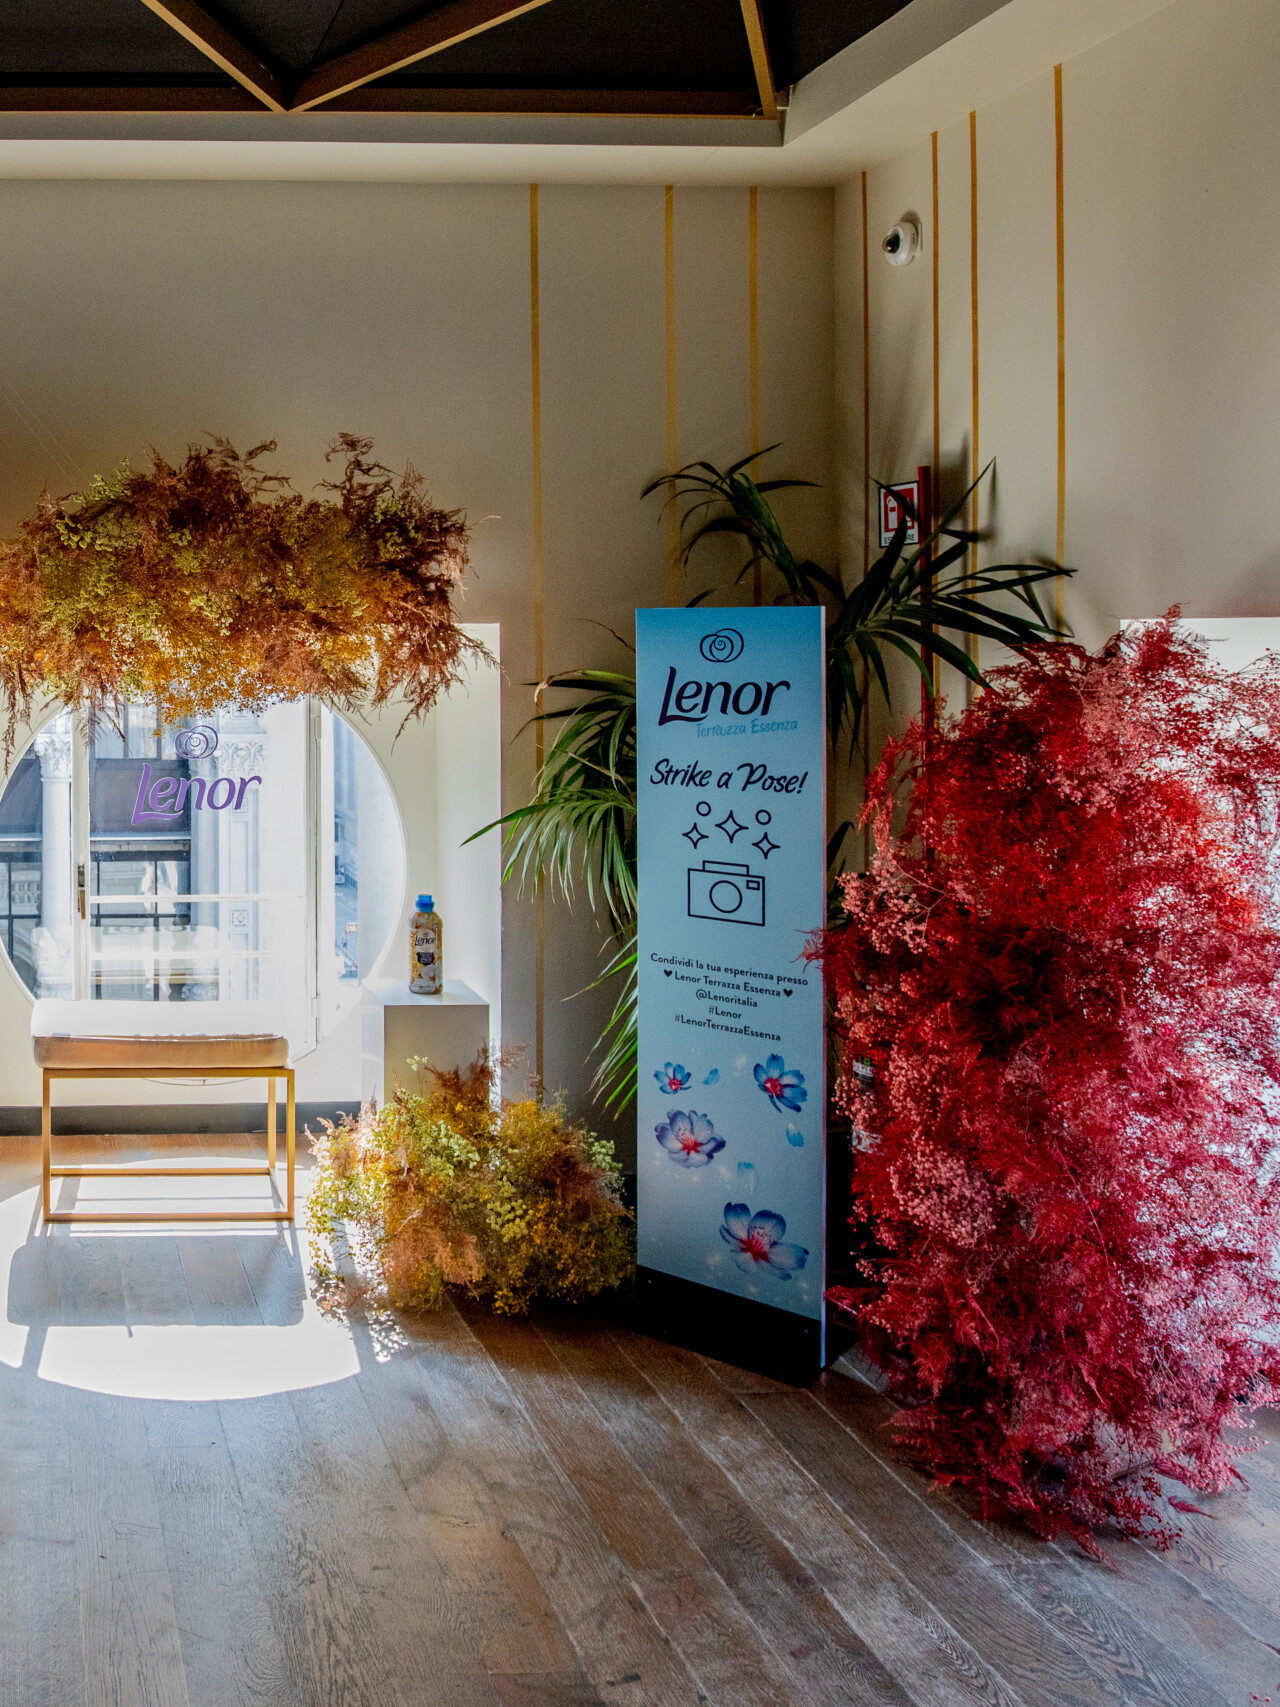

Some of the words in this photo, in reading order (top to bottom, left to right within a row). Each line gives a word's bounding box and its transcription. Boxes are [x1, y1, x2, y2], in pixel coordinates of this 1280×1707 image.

[658, 666, 791, 727] Lenor
[696, 721, 746, 738] Terrazza
[750, 718, 798, 734] Essenza
[650, 758, 713, 788] Strike
[716, 771, 734, 790] a
[736, 762, 809, 794] Pose!
[131, 762, 262, 825] Lenor
[415, 934, 435, 946] Lenor
[650, 952, 694, 968] Condividi
[696, 960, 704, 970] la
[706, 963, 722, 973] tua
[723, 967, 774, 980] esperienza
[776, 975, 809, 986] presso
[674, 971, 701, 984] Lenor
[703, 975, 741, 990] Terrazza
[743, 982, 781, 997] Essenza
[695, 988, 758, 1008] @Lenoritalia
[708, 1005, 742, 1020] #Lenor
[674, 1014, 781, 1042] #LenorTerrazzaEssenza
